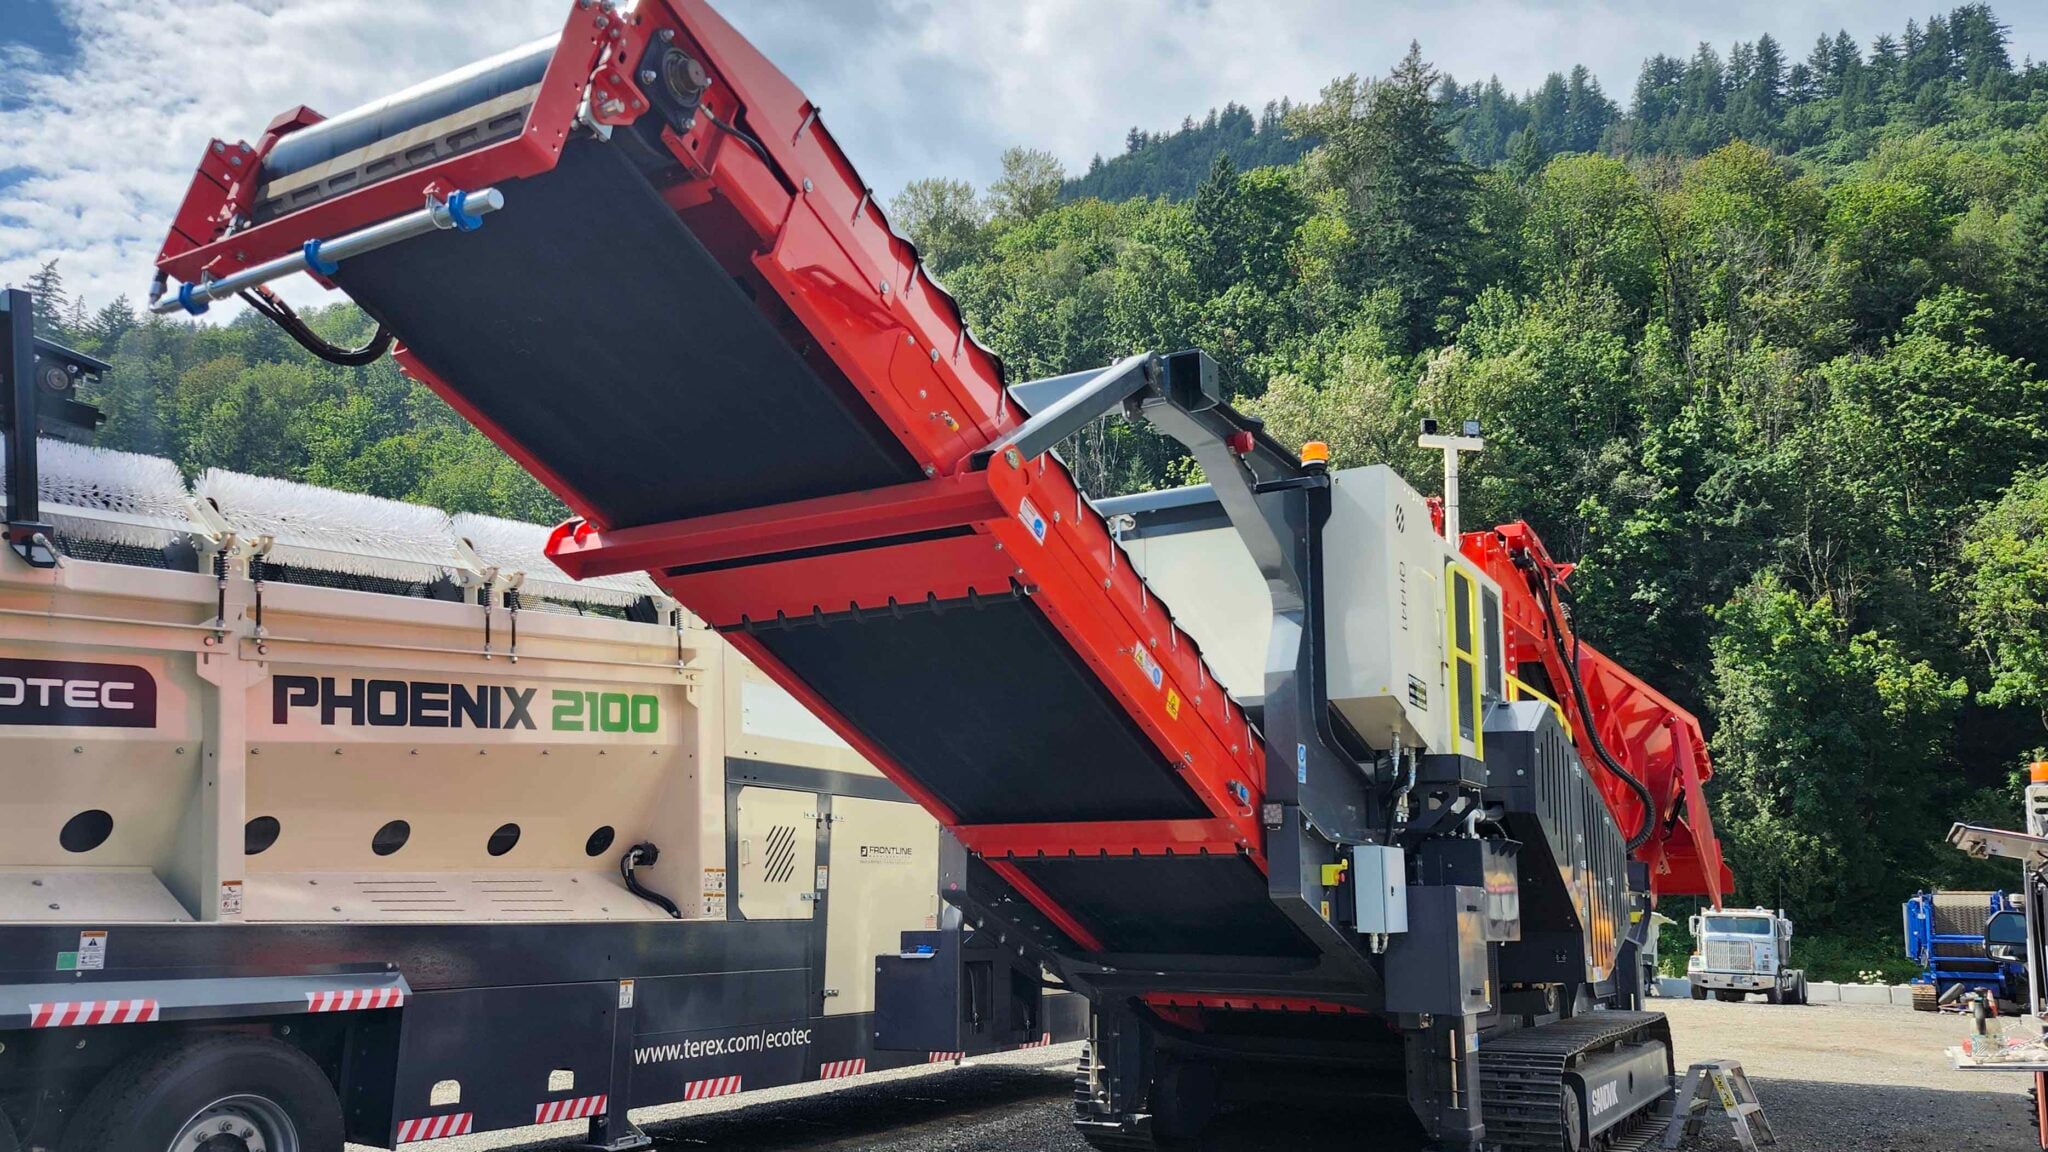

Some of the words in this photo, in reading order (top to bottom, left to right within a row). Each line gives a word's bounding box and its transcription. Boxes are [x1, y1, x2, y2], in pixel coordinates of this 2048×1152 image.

[272, 675, 537, 730] PHOENIX
[551, 689, 659, 734] 2100
[869, 846, 913, 856] FRONTLINE
[634, 1028, 812, 1065] www.terex.com/ecotec
[1592, 1079, 1619, 1117] SANDVIK
